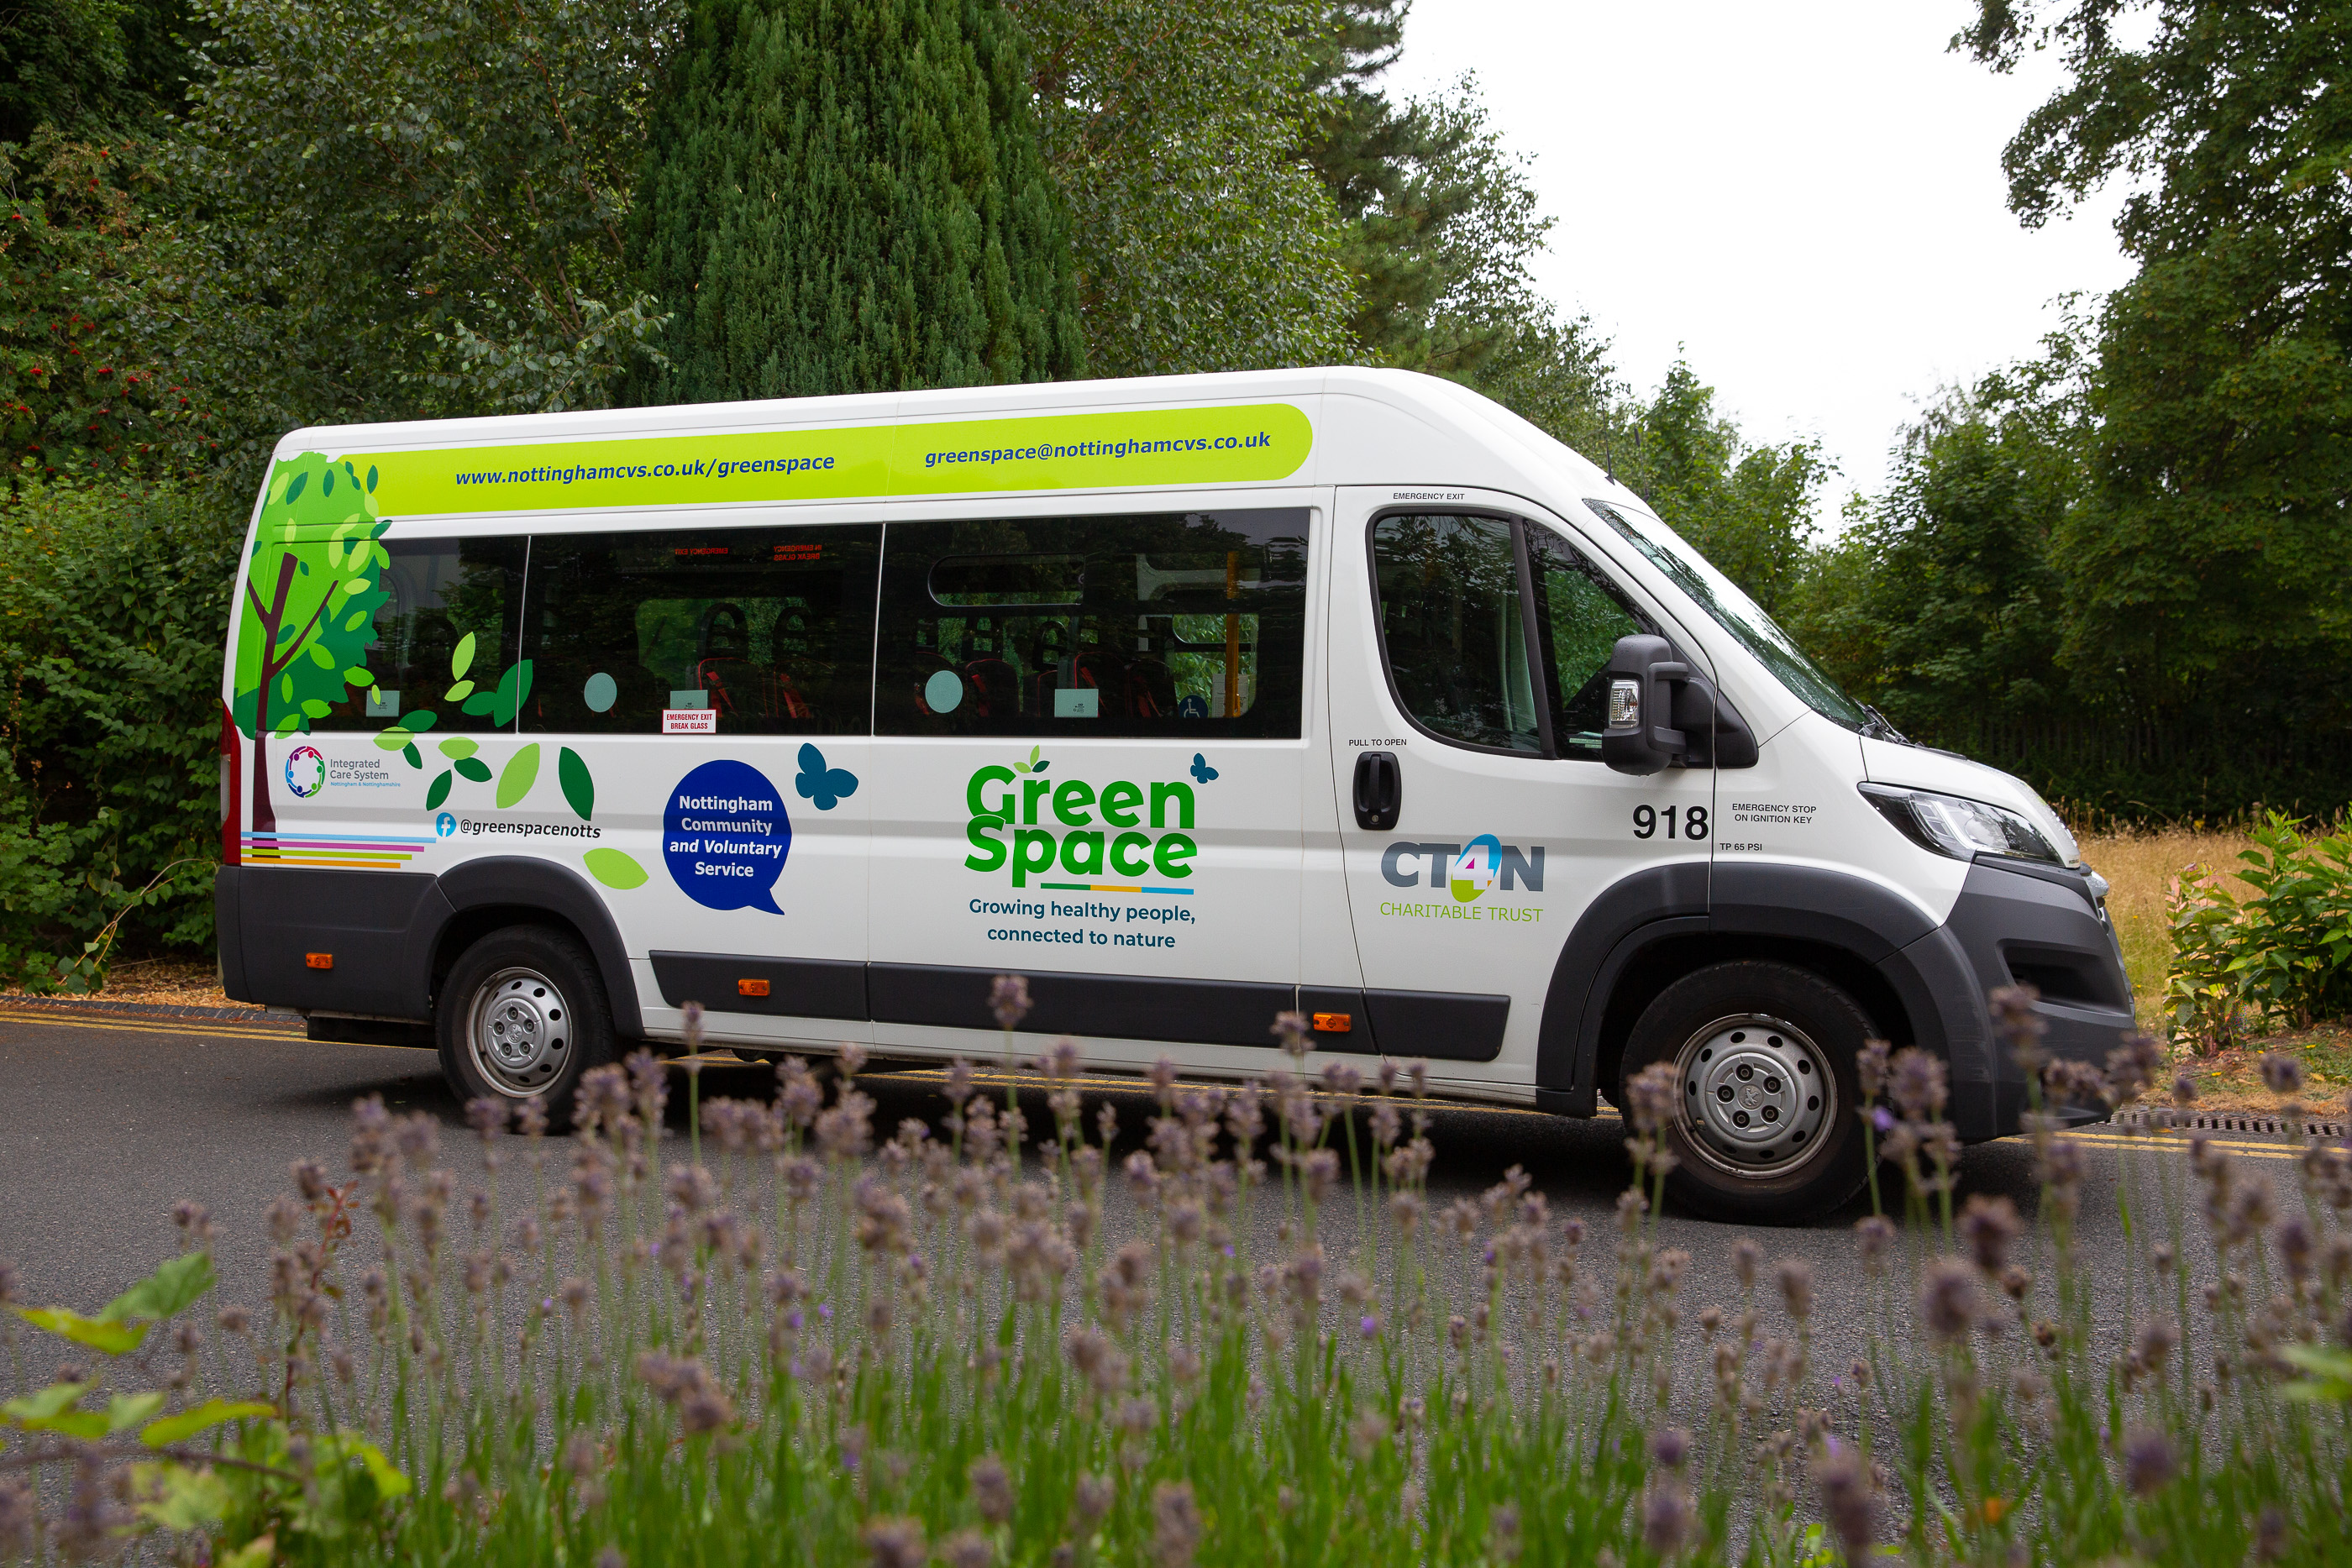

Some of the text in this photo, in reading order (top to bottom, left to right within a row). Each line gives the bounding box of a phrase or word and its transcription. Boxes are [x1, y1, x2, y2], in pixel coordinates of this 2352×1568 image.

[925, 432, 1271, 468] greenspace@nottinghamcvs.co.uk
[455, 454, 835, 485] www.nottinghamcvs.co.uk/greenspace
[330, 758, 381, 770] Integrated
[330, 770, 389, 782] Care System
[679, 795, 773, 814] Nottingham
[966, 764, 1195, 830] Green
[1732, 803, 1817, 814] EMERGENCY STOP
[460, 819, 601, 839] @greenspacenotts
[681, 817, 773, 836] Community
[1632, 804, 1709, 841] 918
[1751, 815, 1791, 823] IGNITION
[669, 839, 783, 859] and Voluntary
[964, 815, 1198, 889] Space
[1719, 842, 1731, 851] TP
[695, 862, 754, 878] Service
[1381, 841, 1546, 892] CT4N
[969, 899, 1196, 925] Growing healthy people,
[1379, 902, 1544, 922] CHARITABLE TRUST
[987, 928, 1176, 948] connected to nature
